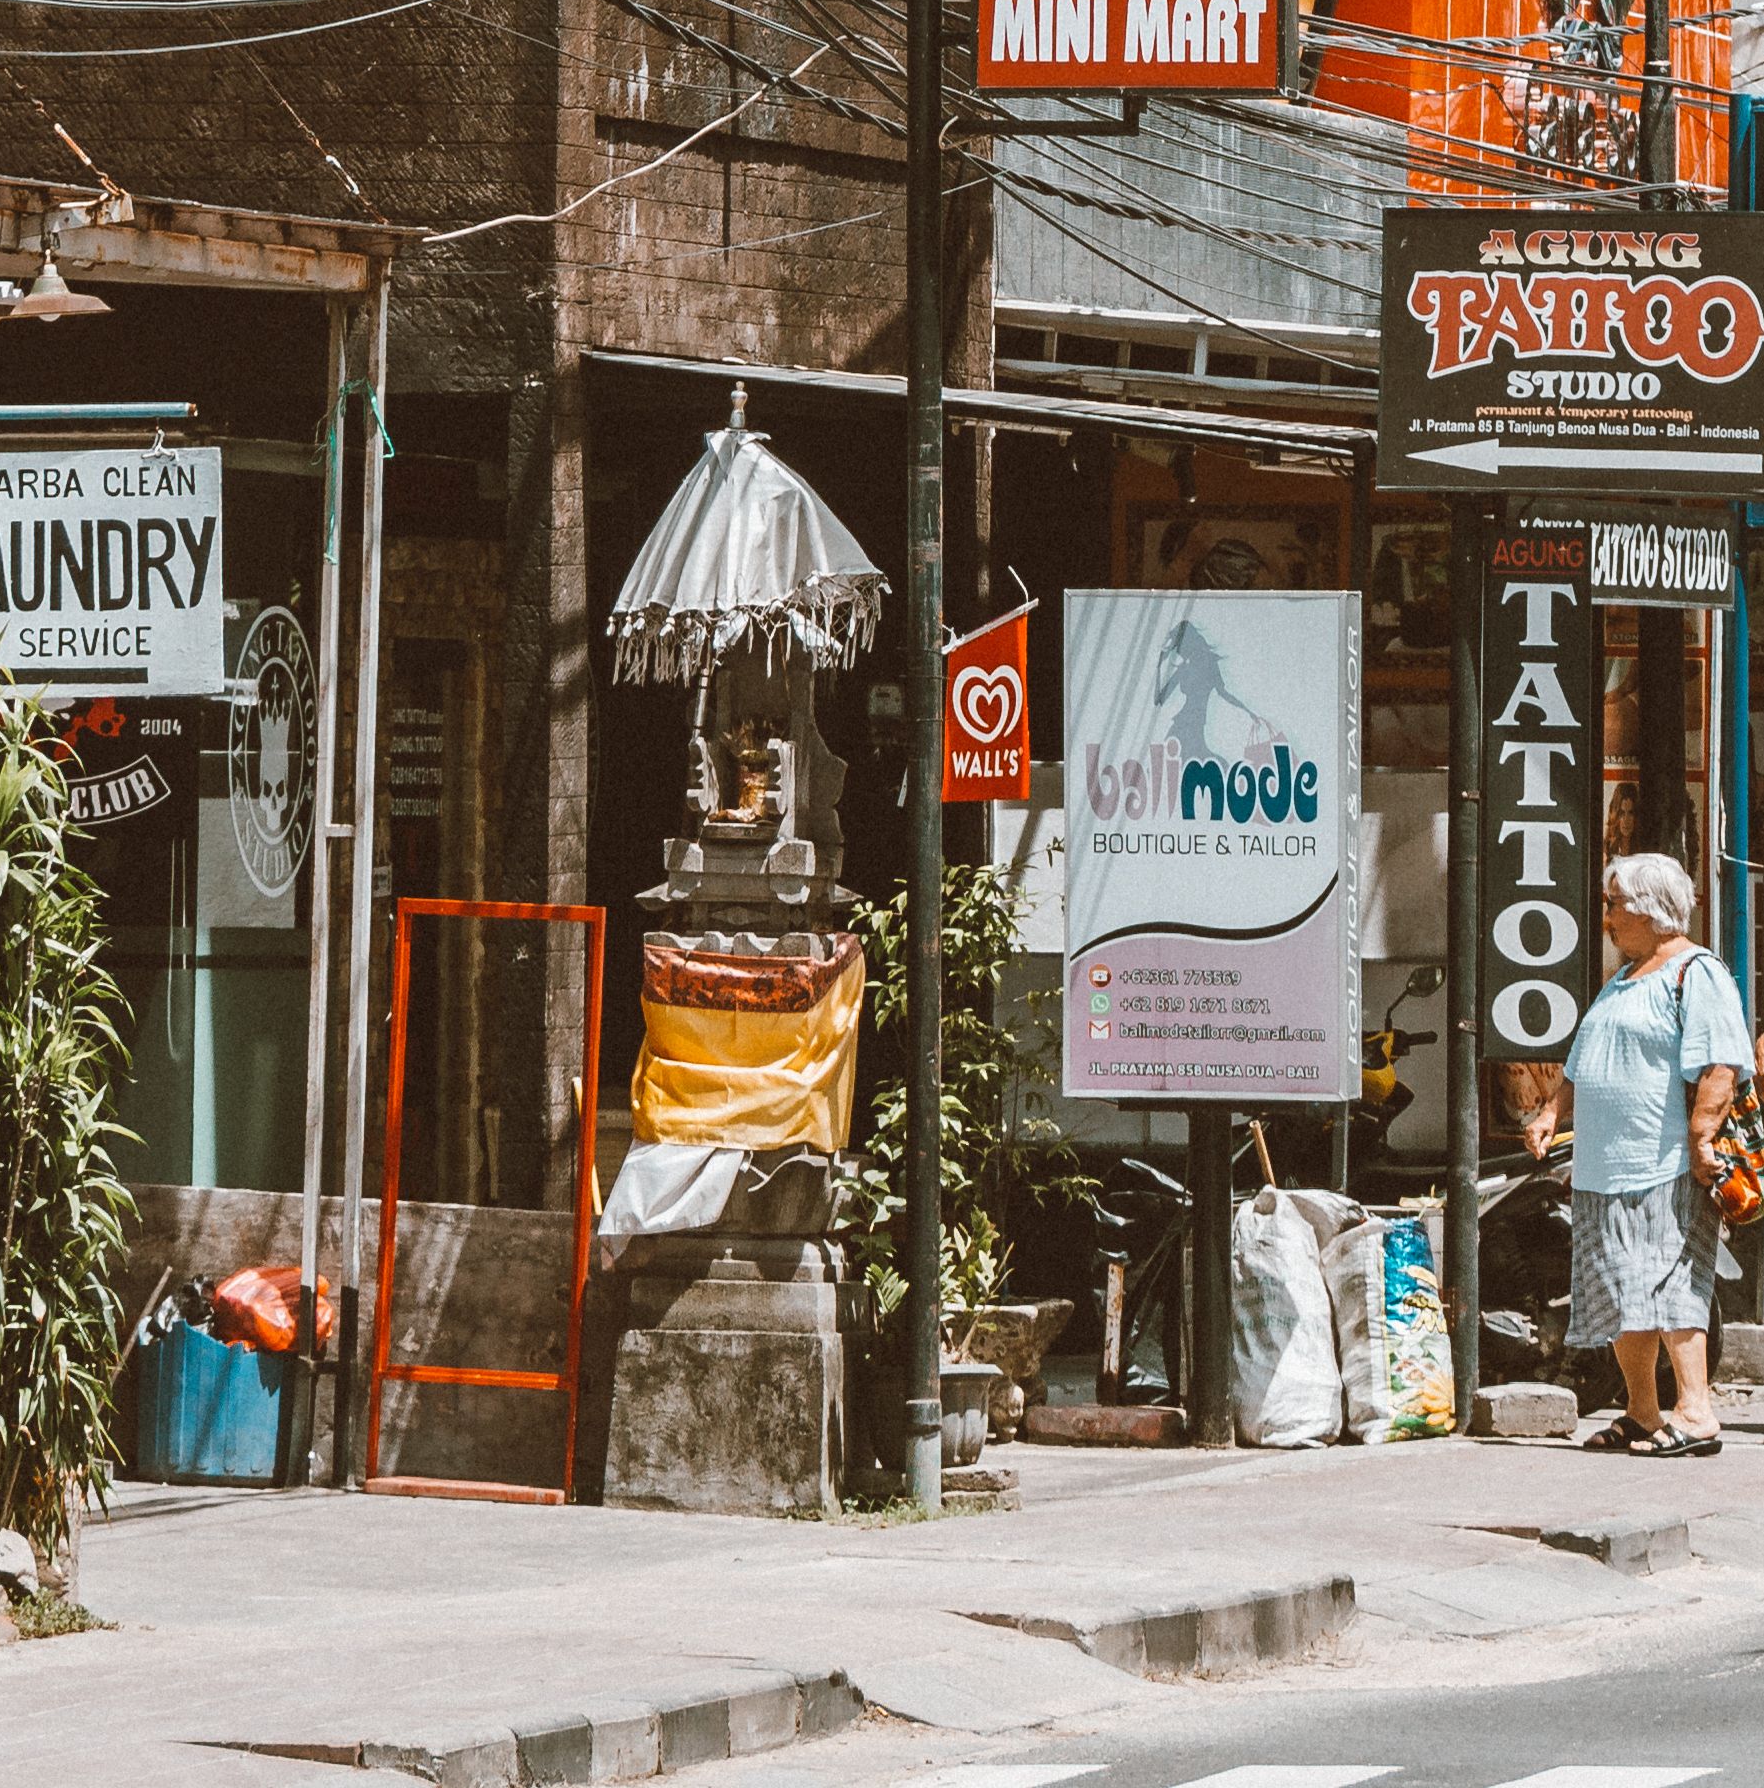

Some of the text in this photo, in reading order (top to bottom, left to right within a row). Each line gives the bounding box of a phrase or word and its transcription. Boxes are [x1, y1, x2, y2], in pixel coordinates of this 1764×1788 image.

[1479, 229, 1702, 268] AGUNG
[1507, 371, 1661, 400] STUDIO
[1476, 405, 1541, 417] permanent
[1560, 406, 1628, 419] temporary
[1633, 407, 1693, 422] tattooing
[1409, 419, 1759, 440] Jl. Pratama 85 B Tanjung Benoa Nusa Dua Bali Indonesia
[104, 466, 196, 497] CLEAN
[1493, 539, 1583, 568] AGUNG
[1662, 525, 1729, 591] STUDIO
[1345, 624, 1360, 770] TAILOR
[140, 719, 182, 735] 2004
[952, 748, 1020, 779] WALL'S
[71, 769, 156, 819] CLUB
[1491, 582, 1581, 1047] TATTOO
[1093, 832, 1316, 857] BOUTIQUE & TAILOR
[1345, 837, 1360, 1064] BOUTIQUE
[1120, 970, 1179, 985] +62361
[1120, 997, 1150, 1012] +62
[1155, 998, 1184, 1012] 819
[1190, 998, 1226, 1013] 1671
[1088, 1063, 1319, 1079] JL. PRATAMA 85B NUSA DUA BALI
